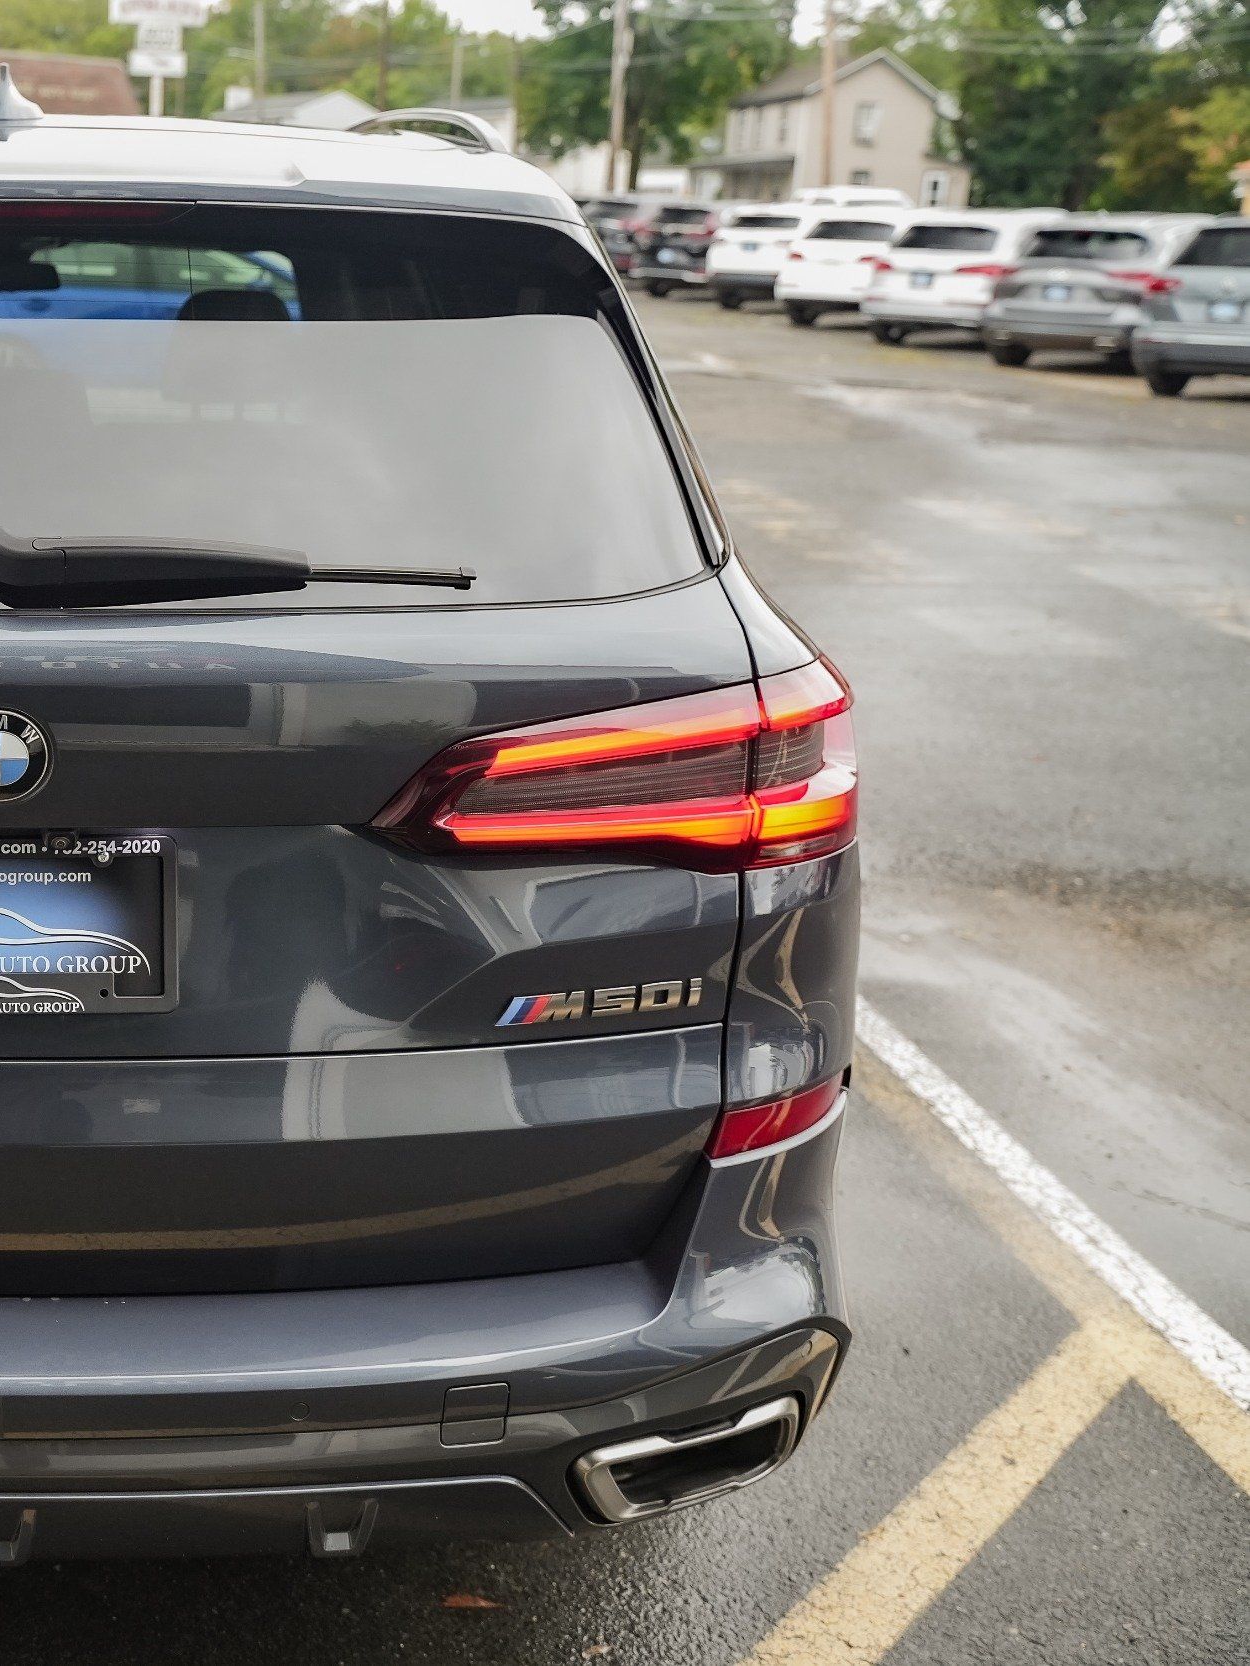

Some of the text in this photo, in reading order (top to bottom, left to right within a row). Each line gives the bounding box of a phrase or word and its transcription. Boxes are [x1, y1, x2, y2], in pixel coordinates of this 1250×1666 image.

[54, 839, 161, 855] 2-254-2020
[56, 955, 142, 974] GROUP
[34, 1002, 80, 1014] GROUP
[532, 977, 703, 1023] M50i
